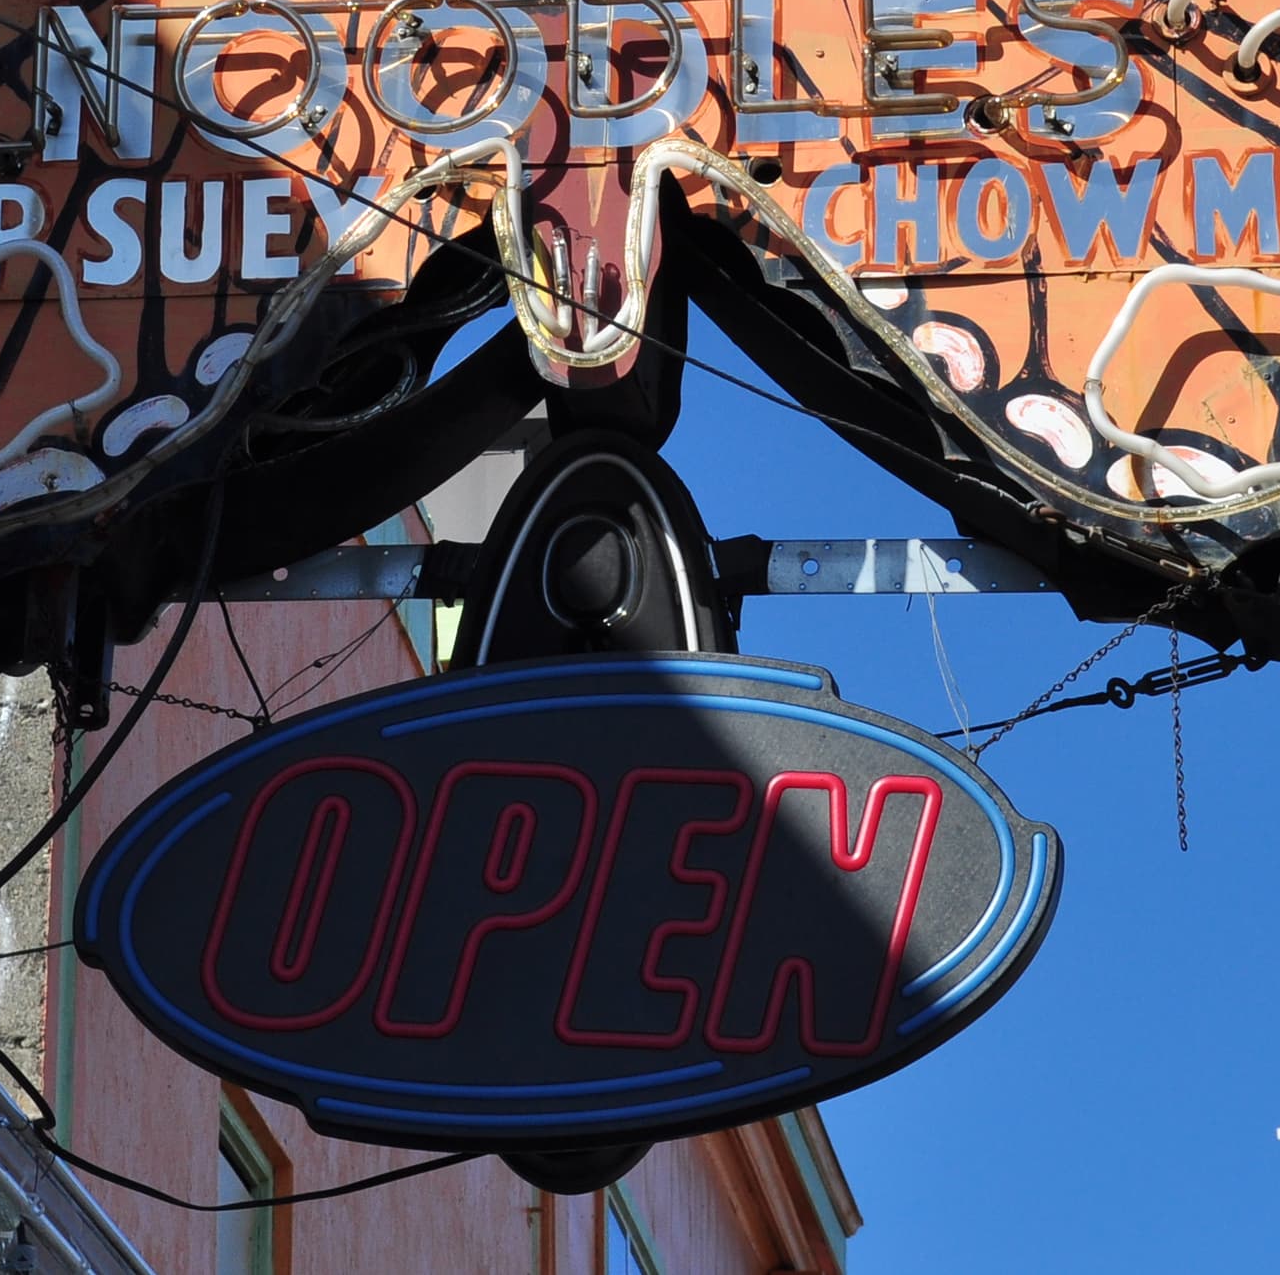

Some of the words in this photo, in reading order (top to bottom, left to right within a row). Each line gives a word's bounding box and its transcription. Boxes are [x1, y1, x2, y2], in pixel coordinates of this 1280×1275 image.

[82, 174, 387, 286] SUEY
[802, 155, 1162, 269] CHOW
[200, 755, 943, 1057] OPEN
